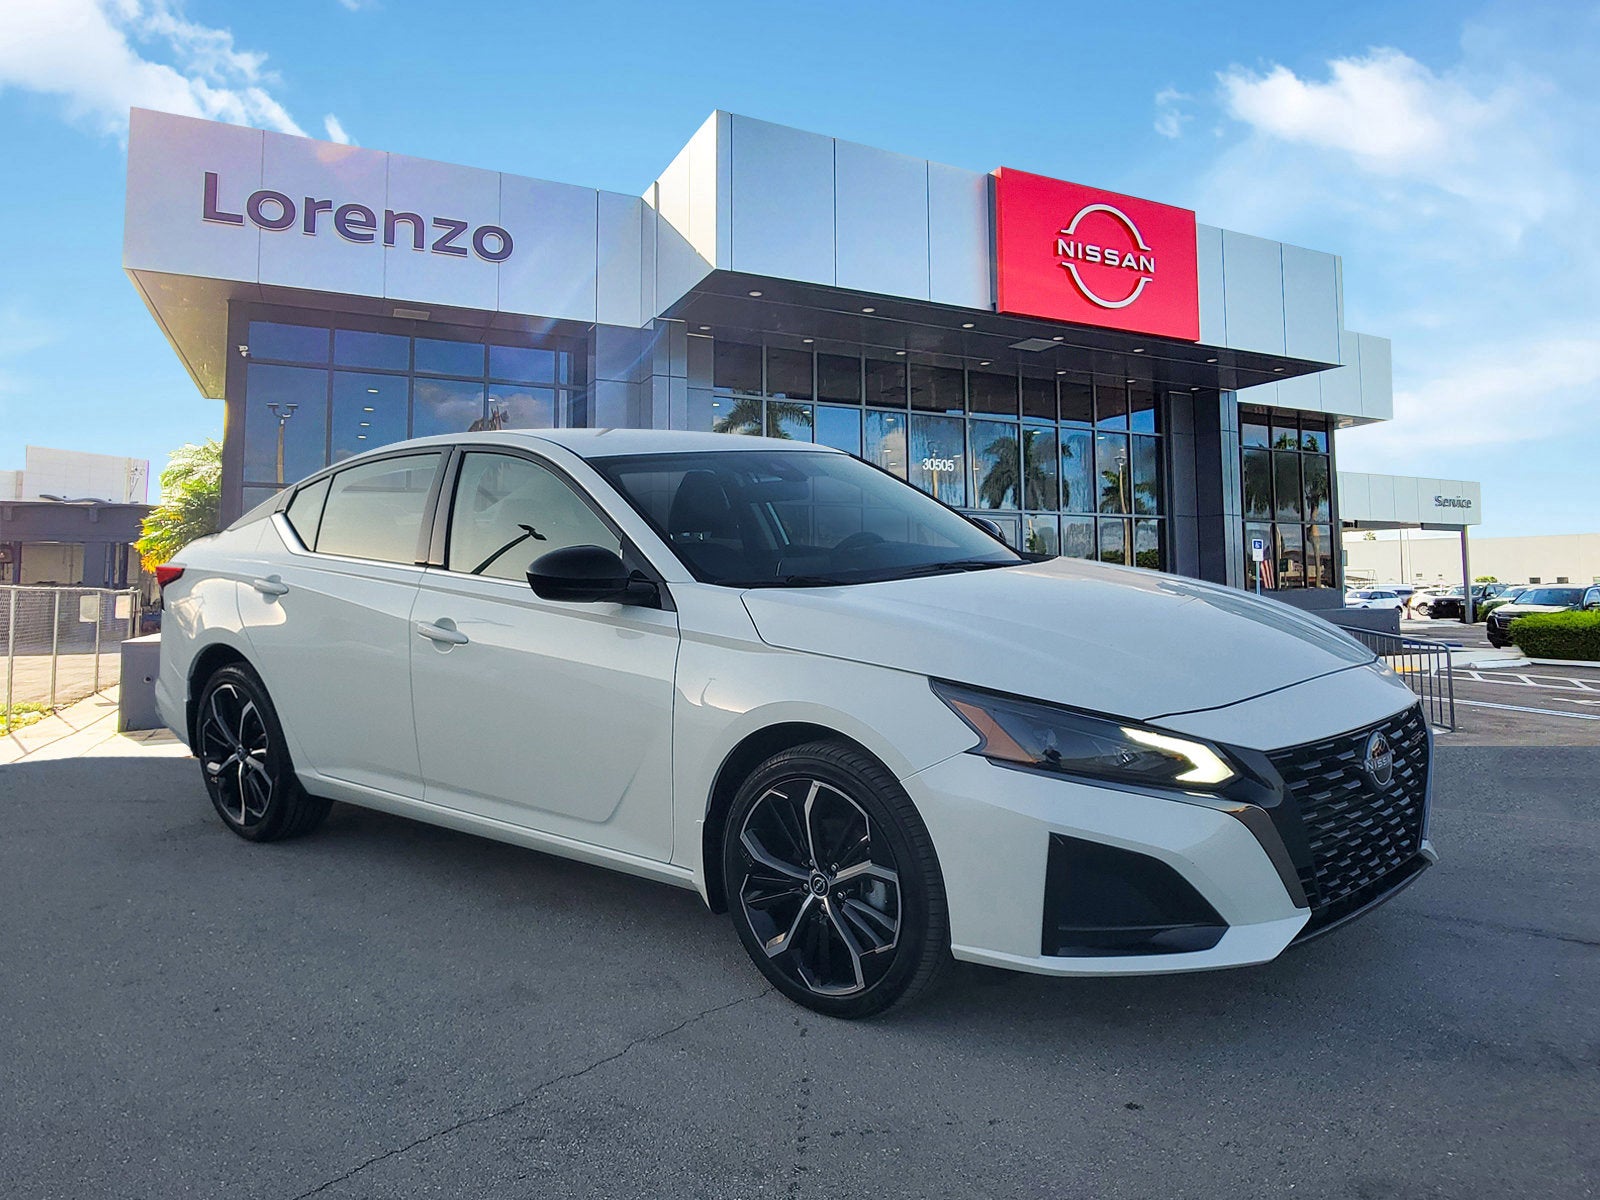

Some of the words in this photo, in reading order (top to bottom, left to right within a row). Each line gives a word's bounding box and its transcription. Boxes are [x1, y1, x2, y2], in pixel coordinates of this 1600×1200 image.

[202, 171, 514, 262] Lorenzo
[1056, 238, 1155, 273] NISSAN
[922, 458, 955, 472] 30505
[1434, 495, 1472, 509] Service
